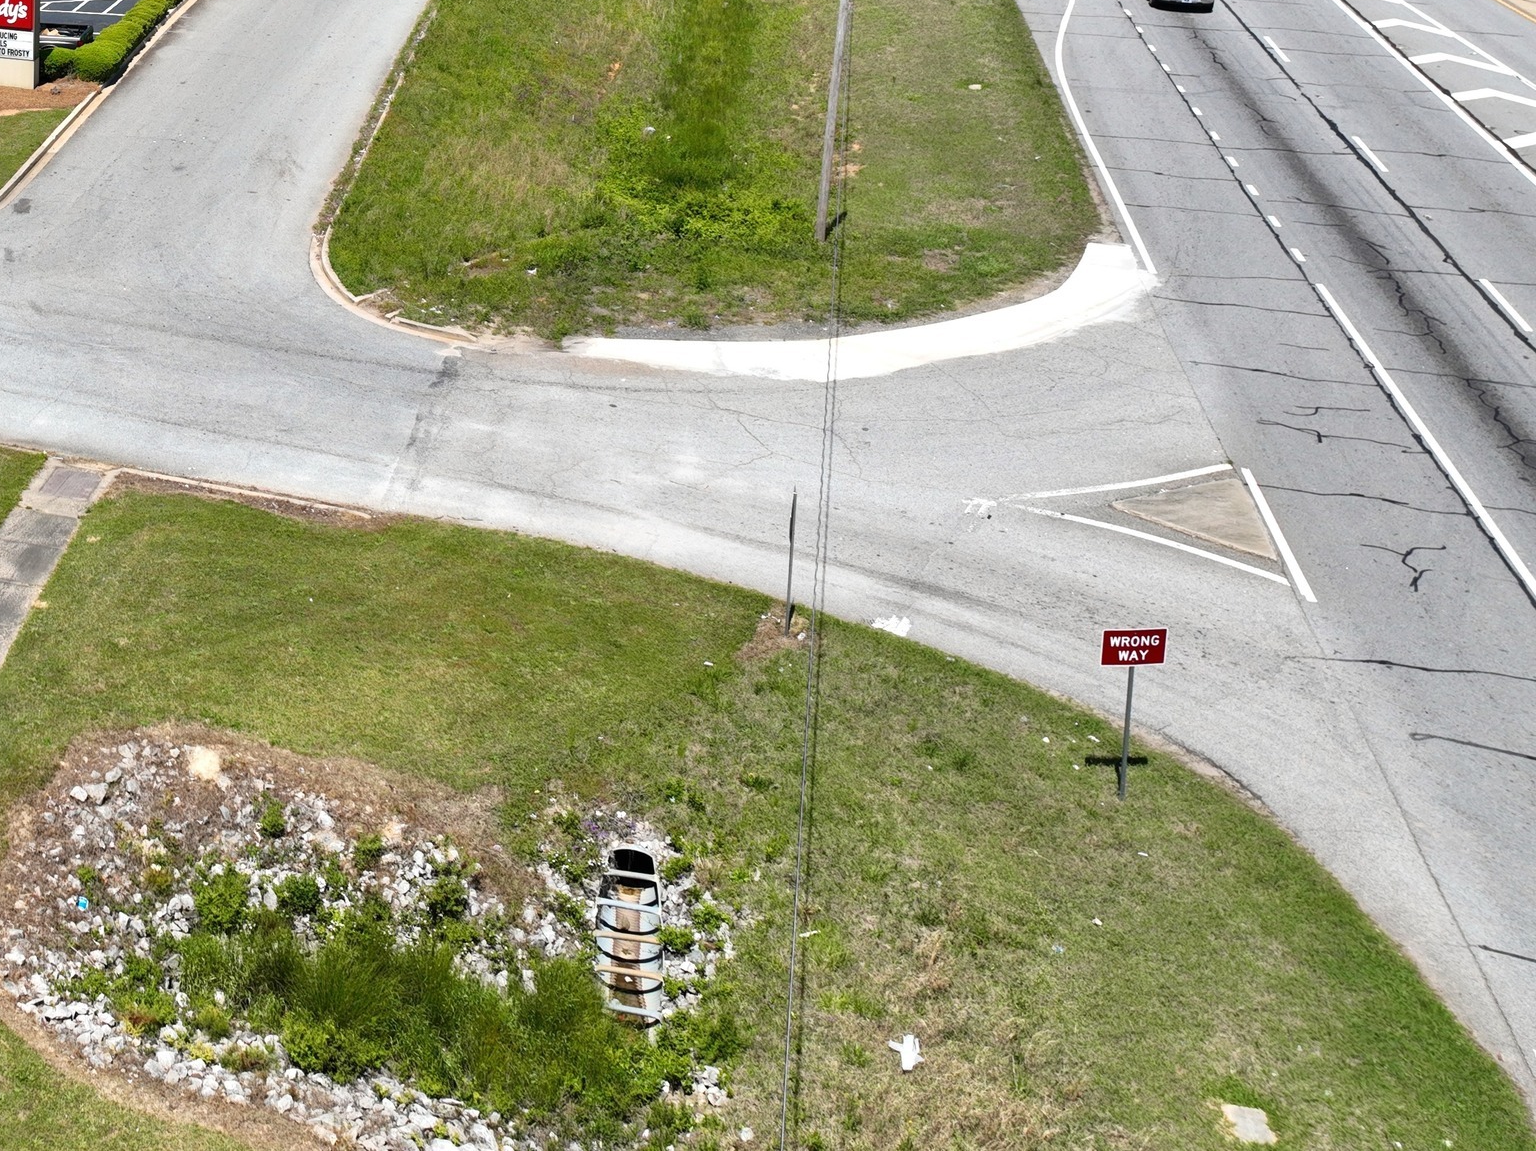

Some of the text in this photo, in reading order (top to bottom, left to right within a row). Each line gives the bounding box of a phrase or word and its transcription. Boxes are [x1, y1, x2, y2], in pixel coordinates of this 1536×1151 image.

[7, 48, 30, 57] FROSTY
[1110, 635, 1160, 647] WRONG
[1118, 649, 1149, 661] WAY
